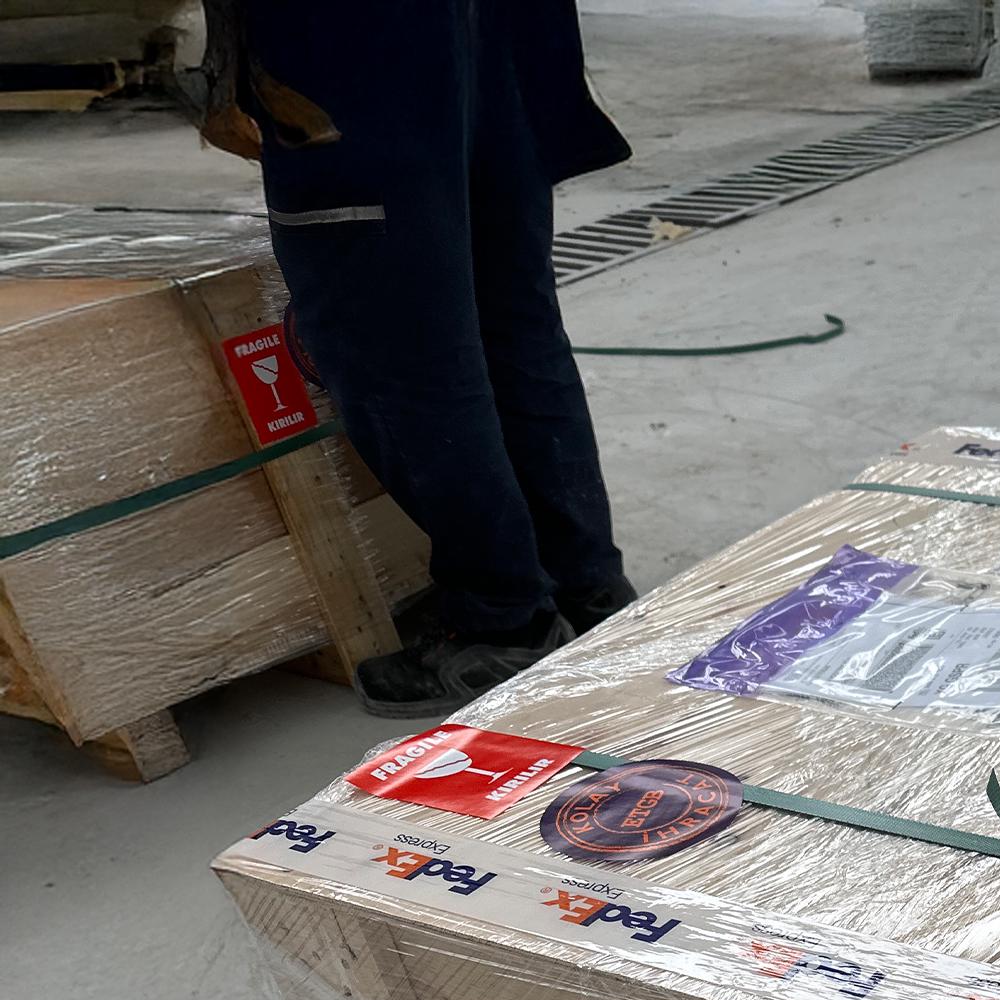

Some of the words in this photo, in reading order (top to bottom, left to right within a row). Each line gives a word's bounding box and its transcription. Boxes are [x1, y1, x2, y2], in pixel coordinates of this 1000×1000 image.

[234, 334, 280, 358] FRAGILE
[267, 411, 304, 432] KIRILIR
[370, 730, 452, 781] FRAGILE
[485, 757, 555, 801] KIRILIR
[570, 782, 622, 834] KOLAY
[621, 789, 665, 828] ETGB
[393, 833, 451, 855] Express
[370, 847, 498, 896] FedEx
[561, 878, 626, 900] Express
[539, 889, 682, 943] FedEx
